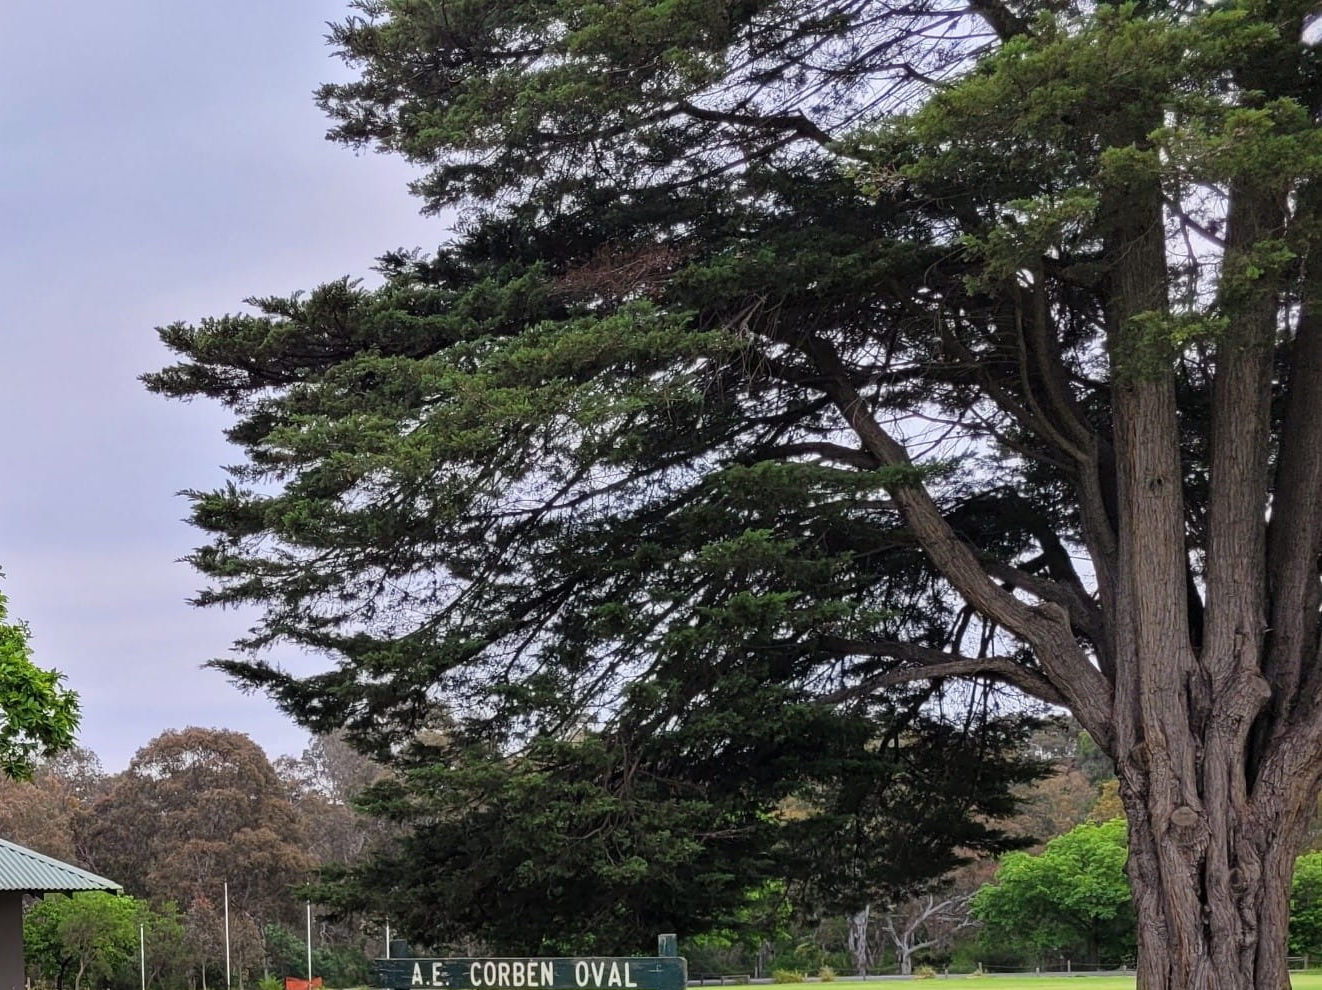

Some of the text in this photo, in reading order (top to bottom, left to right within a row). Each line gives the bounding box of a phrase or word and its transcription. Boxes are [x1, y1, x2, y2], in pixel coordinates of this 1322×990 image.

[411, 961, 638, 988] A.E. CORBEN OVAL
